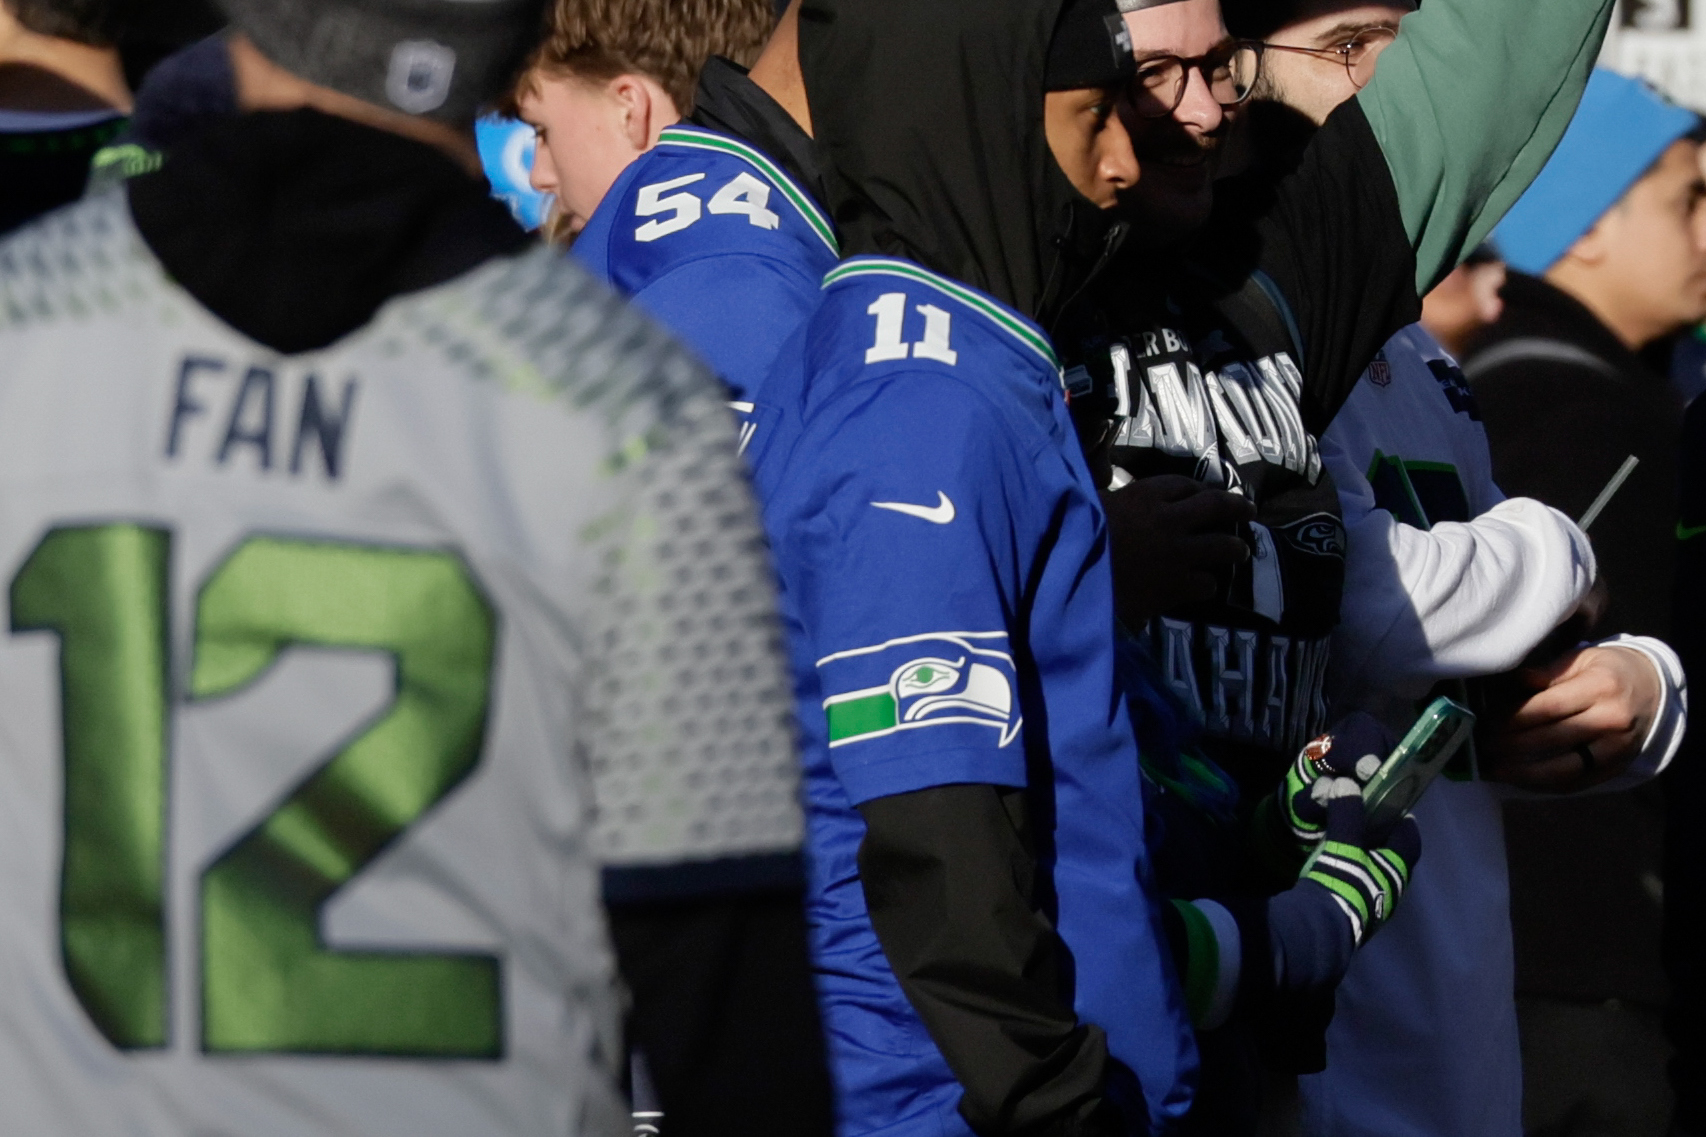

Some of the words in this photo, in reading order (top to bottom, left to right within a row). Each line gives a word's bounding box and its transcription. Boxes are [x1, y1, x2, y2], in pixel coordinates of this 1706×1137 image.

[634, 172, 779, 242] 54
[865, 292, 957, 366] 11
[164, 355, 358, 481] FAN
[9, 520, 508, 1059] 12
